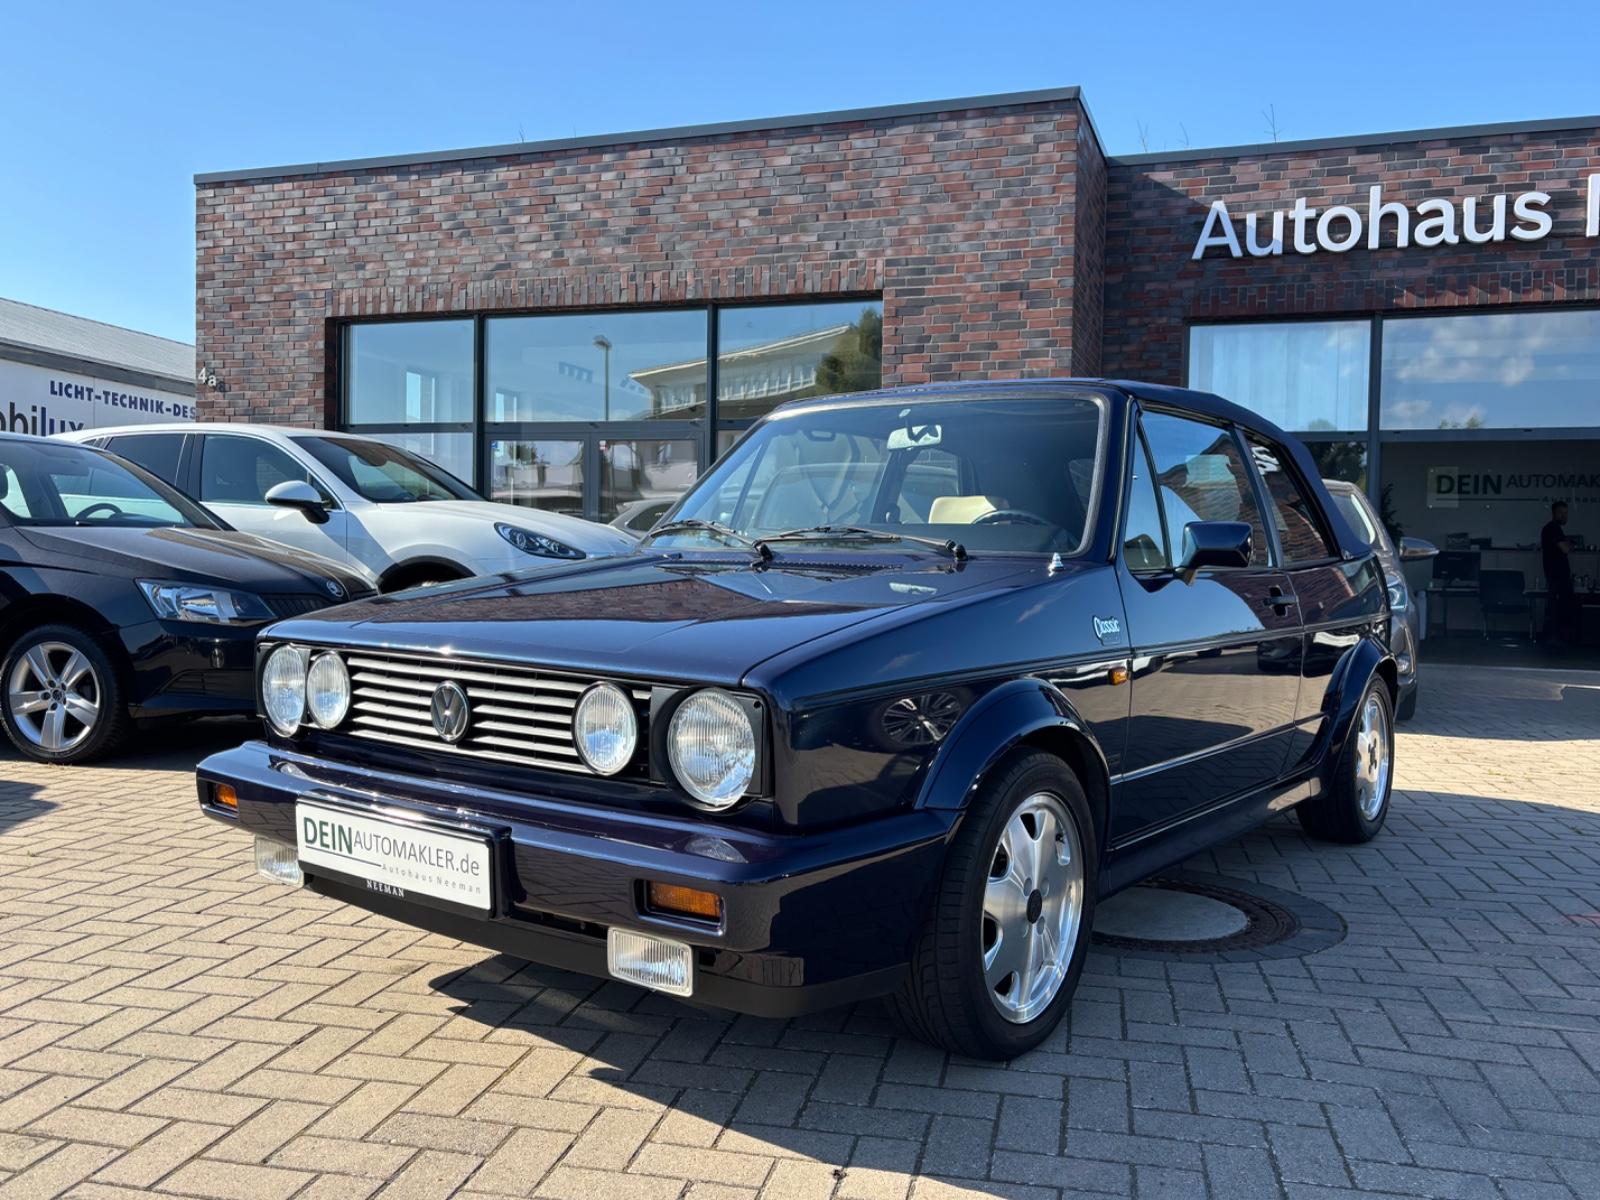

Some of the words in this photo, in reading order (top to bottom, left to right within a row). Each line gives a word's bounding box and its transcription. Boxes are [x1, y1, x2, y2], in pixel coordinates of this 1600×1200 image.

[1191, 185, 1553, 260] Autohaus
[198, 367, 217, 387] 4a
[50, 380, 196, 419] LICHT-TECHNIK-DES
[1436, 474, 1502, 495] DEIN
[1505, 474, 1600, 489] AUTOMAK
[366, 879, 405, 898] NEEMAN
[382, 864, 433, 882] Autohaus
[437, 875, 481, 894] Neeman
